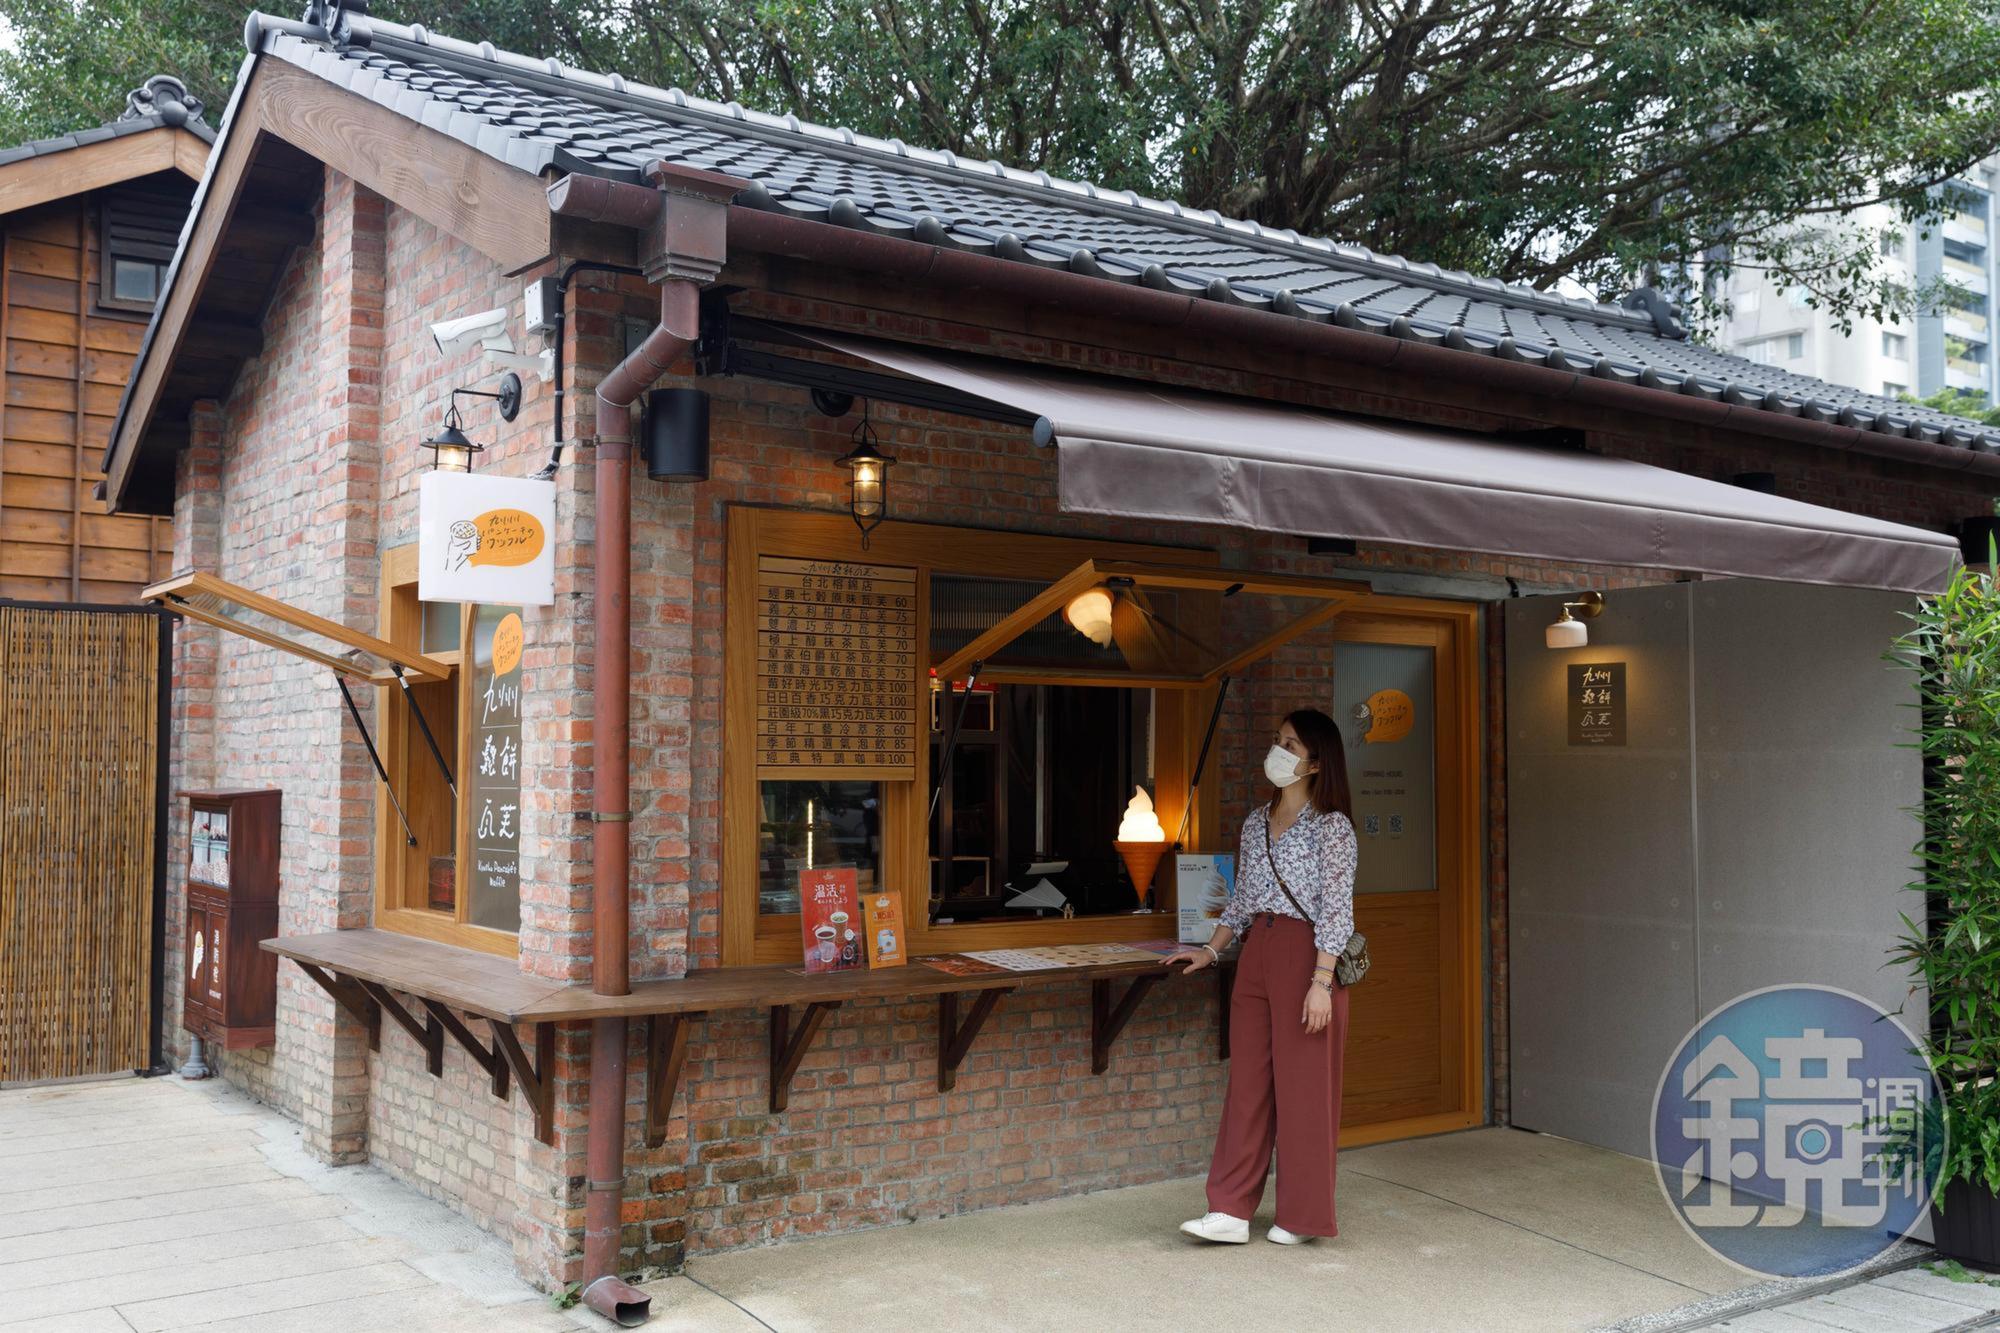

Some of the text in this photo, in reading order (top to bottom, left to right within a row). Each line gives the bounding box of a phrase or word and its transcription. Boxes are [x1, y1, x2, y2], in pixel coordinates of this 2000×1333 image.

[895, 597, 907, 608] 60
[895, 611, 907, 622] 75
[895, 625, 907, 637] 75
[896, 640, 908, 650] 70
[896, 655, 908, 665] 70
[895, 668, 906, 680] 75
[1582, 667, 1611, 686] 九州
[889, 682, 907, 693] 100
[483, 672, 518, 724] 九州
[889, 696, 907, 707] 100
[889, 710, 907, 721] 100
[894, 725, 906, 735] 60
[894, 739, 906, 750] 85
[888, 754, 906, 764] 100
